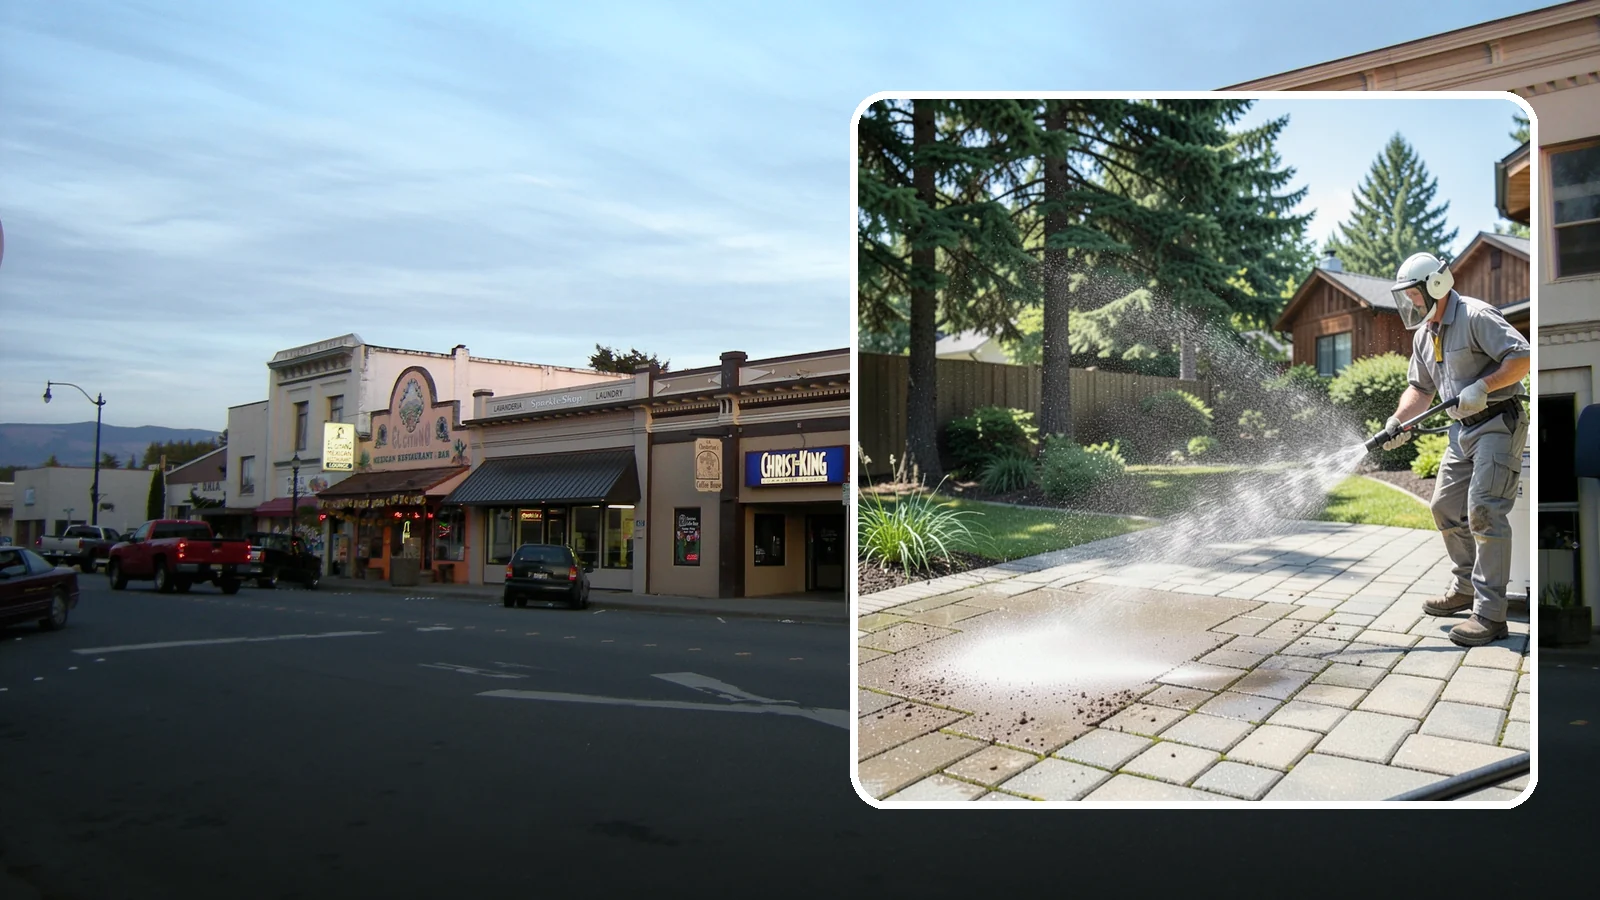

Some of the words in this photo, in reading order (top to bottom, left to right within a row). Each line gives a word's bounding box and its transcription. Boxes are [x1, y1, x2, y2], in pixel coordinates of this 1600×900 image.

[493, 402, 522, 413] LAVANDERIA
[560, 394, 583, 405] Shop
[595, 388, 623, 400] LAUNDRY
[373, 454, 396, 464] MEXICAN
[398, 451, 433, 462] RESTAURANT
[438, 450, 450, 459] BAR
[761, 452, 797, 478] CHRIST
[799, 450, 828, 477] KING
